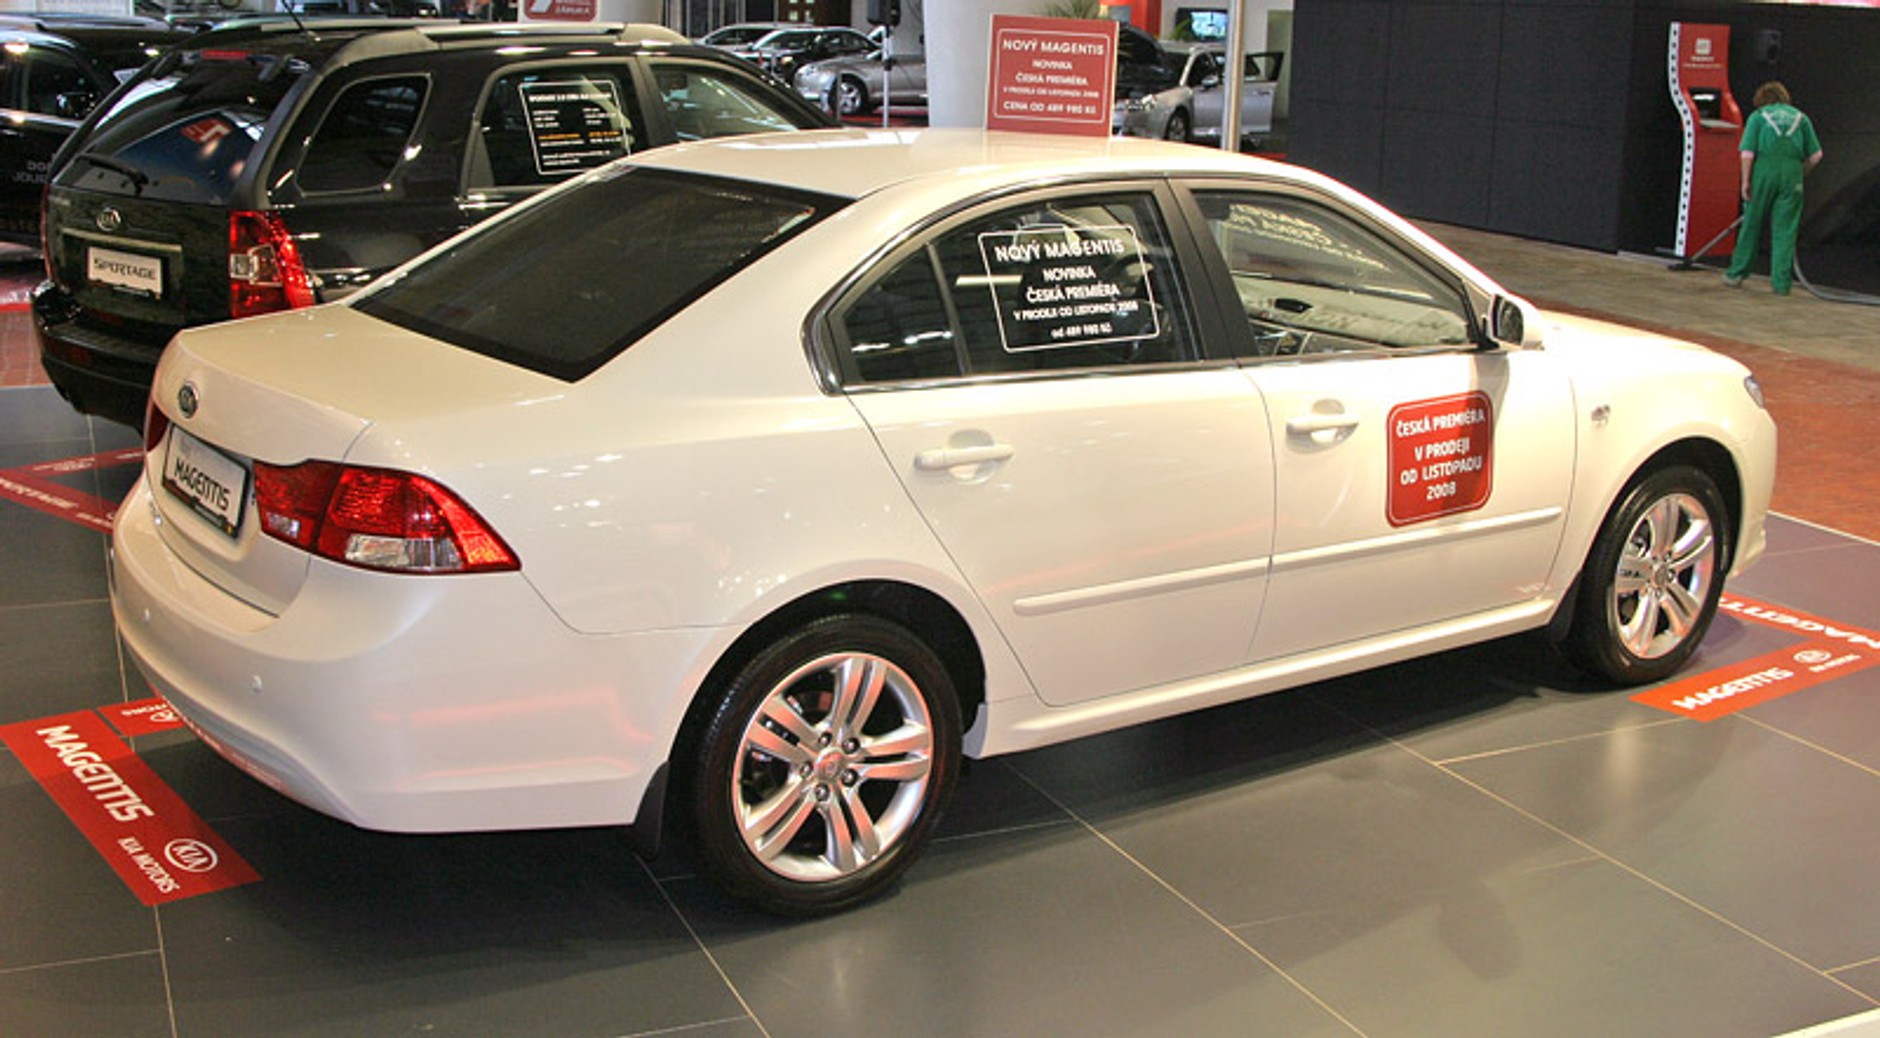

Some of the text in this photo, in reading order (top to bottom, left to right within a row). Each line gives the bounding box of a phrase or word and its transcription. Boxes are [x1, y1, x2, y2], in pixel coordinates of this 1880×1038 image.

[1003, 38, 1104, 55] NOVÝ MAGENTIS
[1032, 59, 1073, 70] NOVINKA
[1004, 101, 1028, 111] CENA
[995, 239, 1125, 262] NOVÝ MAGENTIS
[93, 257, 157, 280] SPORTAGE
[1043, 265, 1096, 282] NOVINKA
[1026, 284, 1065, 303] ČESKÁ
[1396, 408, 1485, 438] ČESKÁ PREMIÉRA
[1414, 437, 1470, 461] V PRODEJI
[1400, 455, 1482, 485] OD LISTOPADU
[173, 457, 231, 511] MAGENTIS
[1426, 481, 1457, 501] 2008
[1672, 667, 1794, 710] MAGENTIS
[36, 725, 154, 822] MAGENTIS
[118, 836, 180, 894] KIA MOTORS
